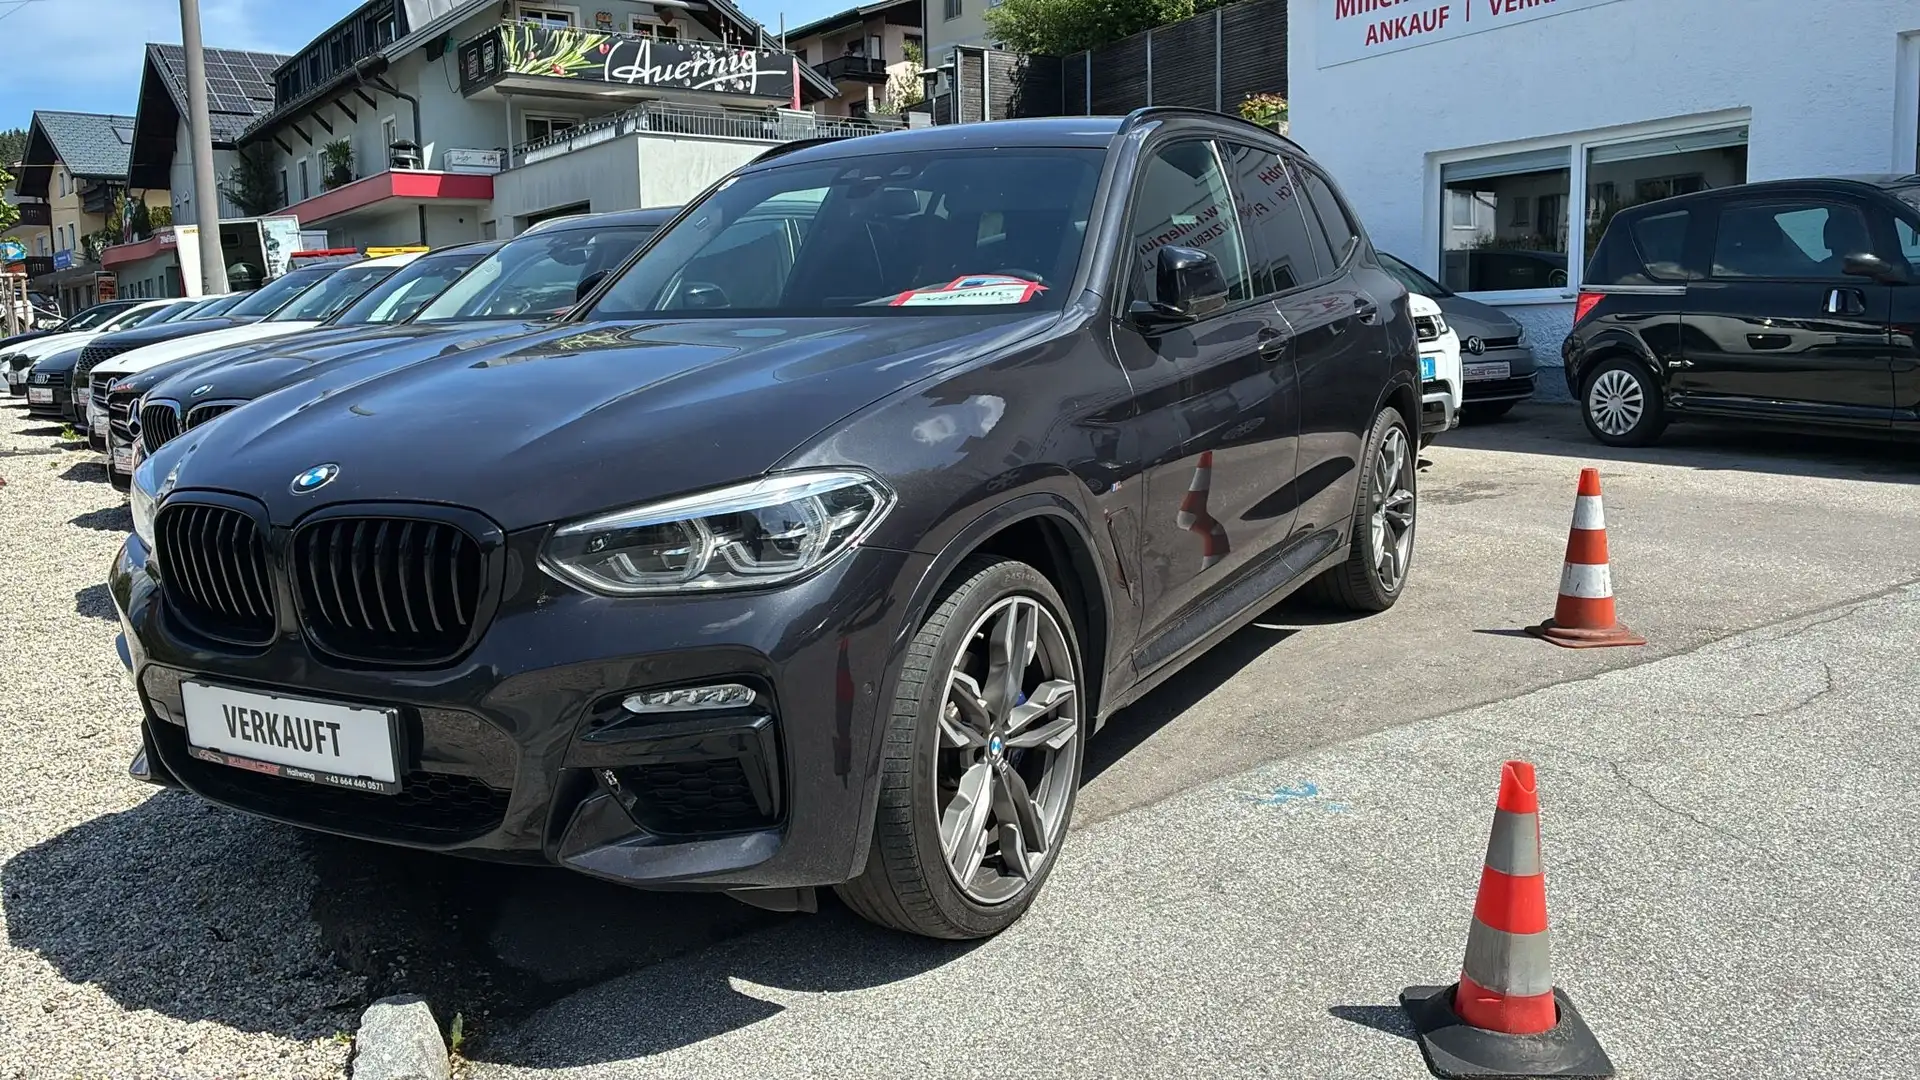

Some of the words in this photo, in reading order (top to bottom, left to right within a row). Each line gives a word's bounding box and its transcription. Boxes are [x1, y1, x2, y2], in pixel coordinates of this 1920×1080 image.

[1365, 5, 1450, 46] ANKAUF
[222, 704, 341, 757] VERKAUFT
[286, 767, 316, 782] Hallwang
[325, 775, 339, 784] +43
[340, 777, 352, 787] 664
[353, 779, 366, 789] 446
[367, 781, 384, 792] 0571
